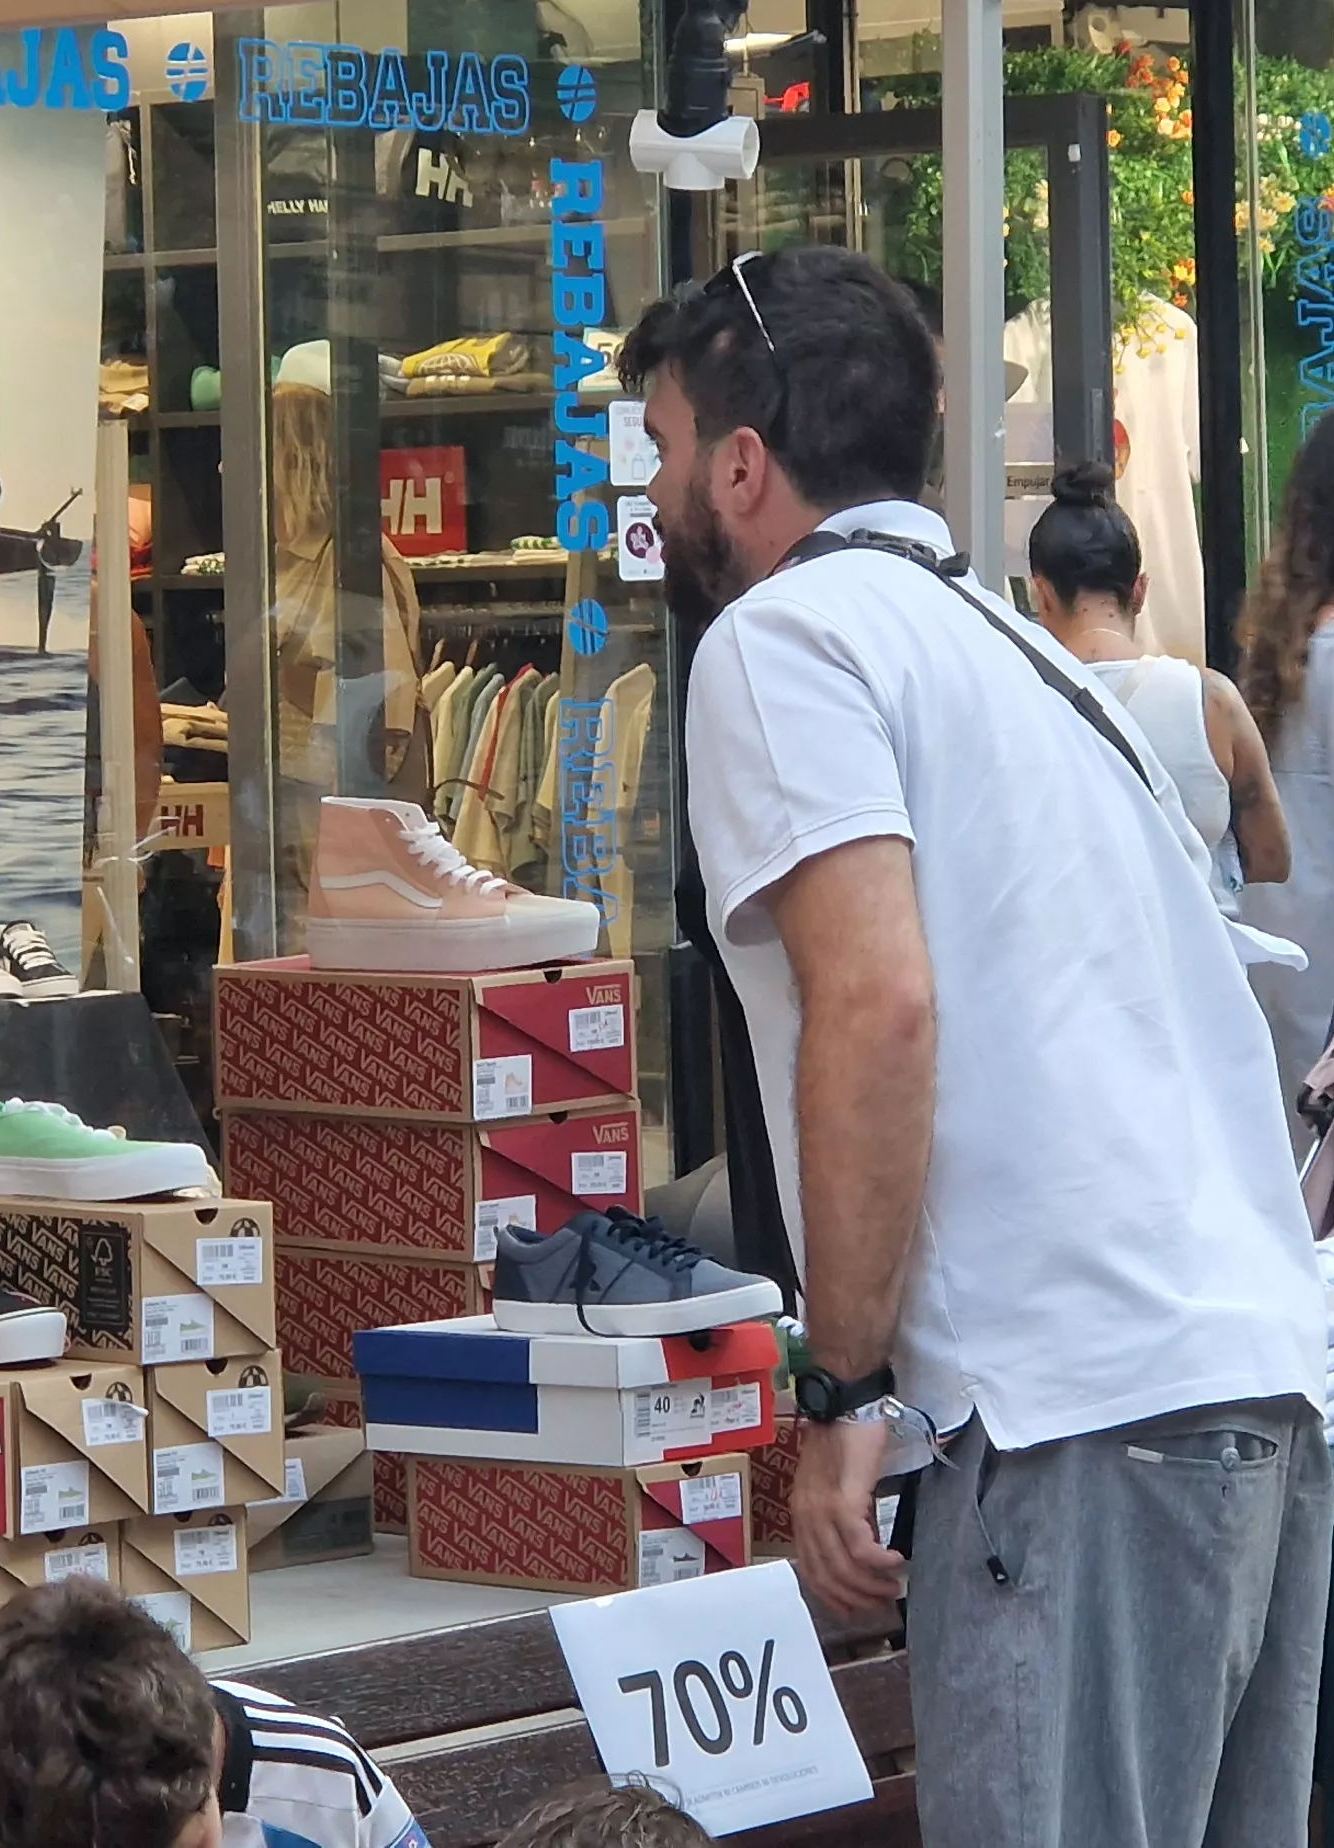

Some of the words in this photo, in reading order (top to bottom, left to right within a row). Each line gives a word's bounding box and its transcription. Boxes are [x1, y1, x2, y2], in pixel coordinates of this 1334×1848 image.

[239, 38, 530, 135] REBAJAS
[550, 158, 610, 553] REBAJAS
[1006, 476, 1050, 490] Empujar
[281, 993, 318, 1032] VANS
[308, 985, 346, 1024] VANS
[586, 984, 621, 1005] VANS
[227, 1011, 263, 1048] VANS
[254, 1002, 291, 1041] VANS
[349, 1012, 387, 1052] VANS
[377, 1003, 415, 1044] VANS
[405, 996, 443, 1035] VANS
[267, 1037, 303, 1077] VANS
[293, 1030, 331, 1069] VANS
[321, 1021, 358, 1060] VANS
[390, 1041, 428, 1080] VANS
[418, 1032, 457, 1072] VANS
[240, 1046, 277, 1085] VANS
[334, 1057, 371, 1097] VANS
[362, 1049, 399, 1089] VANS
[290, 1130, 326, 1168] VANS
[318, 1125, 353, 1161] VANS
[592, 1122, 629, 1145] VANS
[237, 1145, 272, 1178] VANS
[265, 1138, 299, 1177] VANS
[357, 1149, 394, 1189] VANS
[384, 1141, 420, 1181] VANS
[411, 1134, 448, 1174] VANS
[276, 1172, 311, 1213] VANS
[303, 1166, 339, 1205] VANS
[329, 1158, 366, 1198] VANS
[424, 1171, 461, 1211] VANS
[342, 1193, 380, 1234] VANS
[369, 1186, 406, 1226] VANS
[397, 1179, 434, 1219] VANS
[7, 1230, 42, 1270] VANS
[32, 1222, 67, 1263] VANS
[44, 1258, 79, 1299] VANS
[290, 1268, 327, 1307] VANS
[318, 1261, 355, 1300] VANS
[412, 1274, 450, 1314] VANS
[304, 1304, 342, 1343] VANS
[654, 1396, 671, 1414] 40
[441, 1484, 479, 1526] VANS
[469, 1477, 506, 1518] VANS
[497, 1469, 534, 1510] VANS
[509, 1506, 548, 1548] VANS
[537, 1498, 576, 1542] VANS
[566, 1490, 604, 1534] VANS
[455, 1522, 492, 1564] VANS
[483, 1514, 520, 1557] VANS
[579, 1530, 618, 1572] VANS
[550, 1538, 589, 1579] VANS
[618, 1638, 809, 1768] 70%
